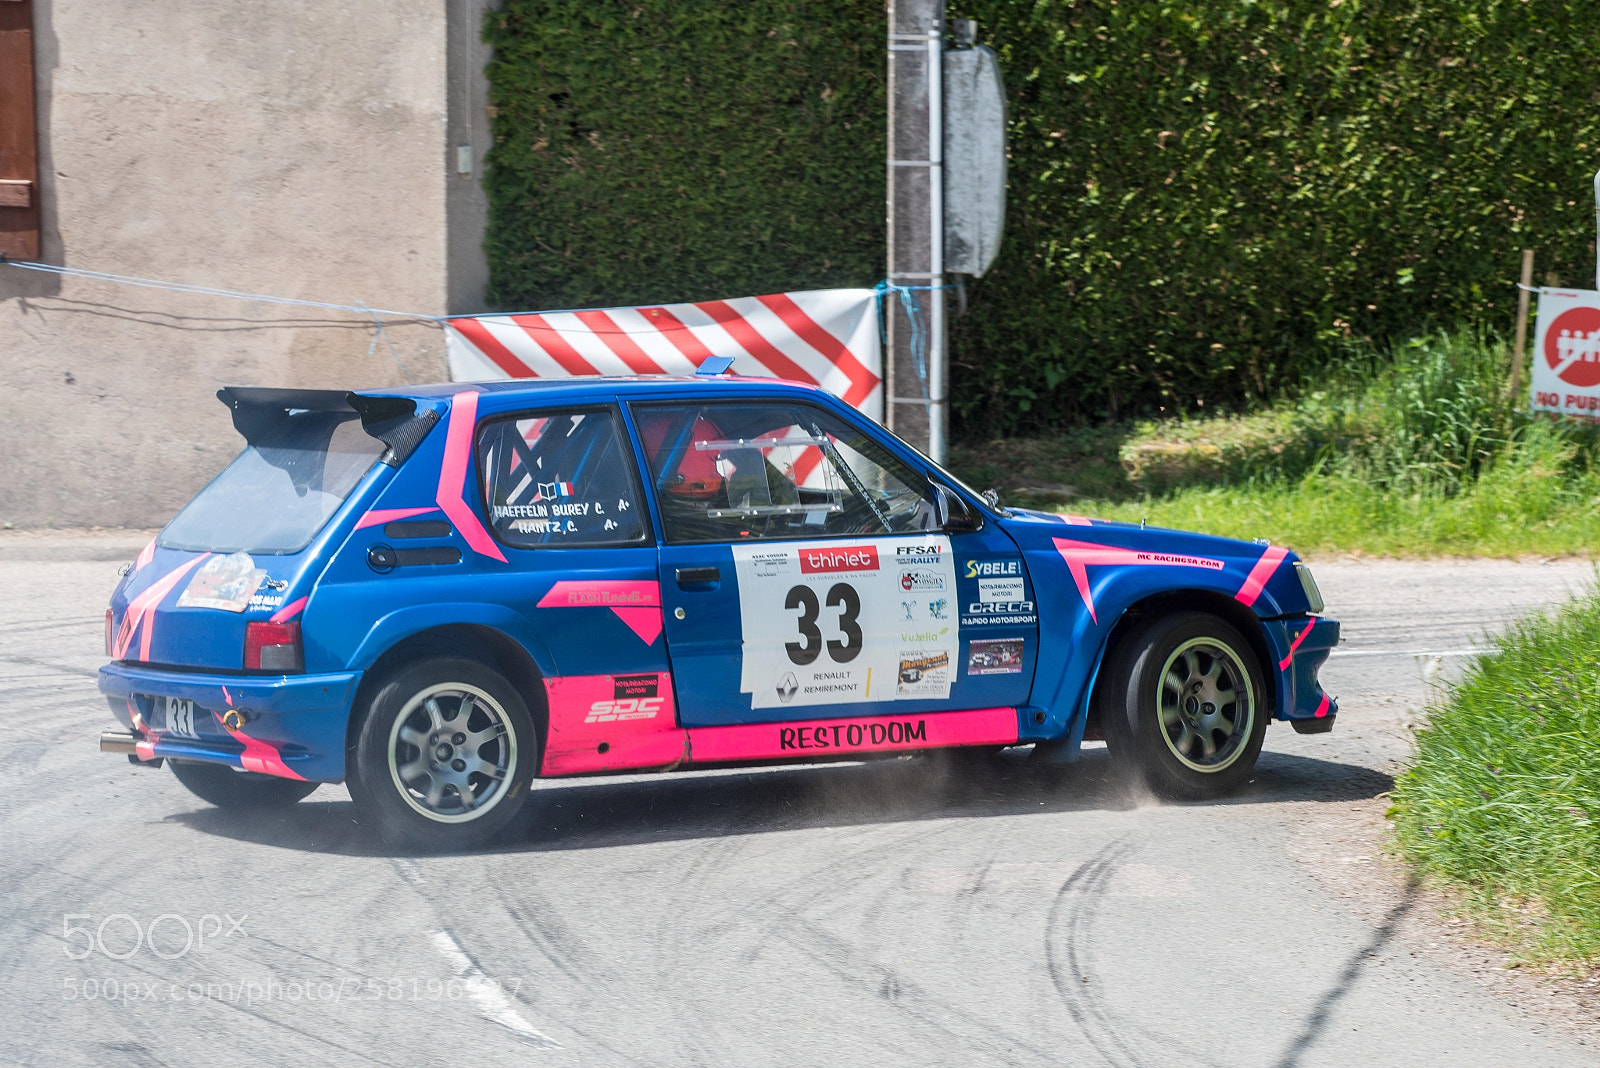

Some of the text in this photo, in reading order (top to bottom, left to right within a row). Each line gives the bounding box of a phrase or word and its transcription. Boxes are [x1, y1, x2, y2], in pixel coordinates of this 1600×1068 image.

[1535, 391, 1600, 411] NO PUB
[492, 504, 548, 518] HAEFFELIN
[552, 502, 590, 517] BUREY
[807, 550, 871, 569] thiriet
[910, 556, 941, 564] RALLYE
[1153, 555, 1220, 568] RACINGSA.COM
[968, 601, 1034, 614] ORECA
[784, 582, 863, 666] 33
[961, 615, 1038, 625] RAPIDO MOTORSPORT
[813, 670, 852, 681] RENAULT
[803, 684, 859, 694] REMIREMONT
[170, 697, 192, 737] 33
[779, 720, 927, 750] RESTO'DOM
